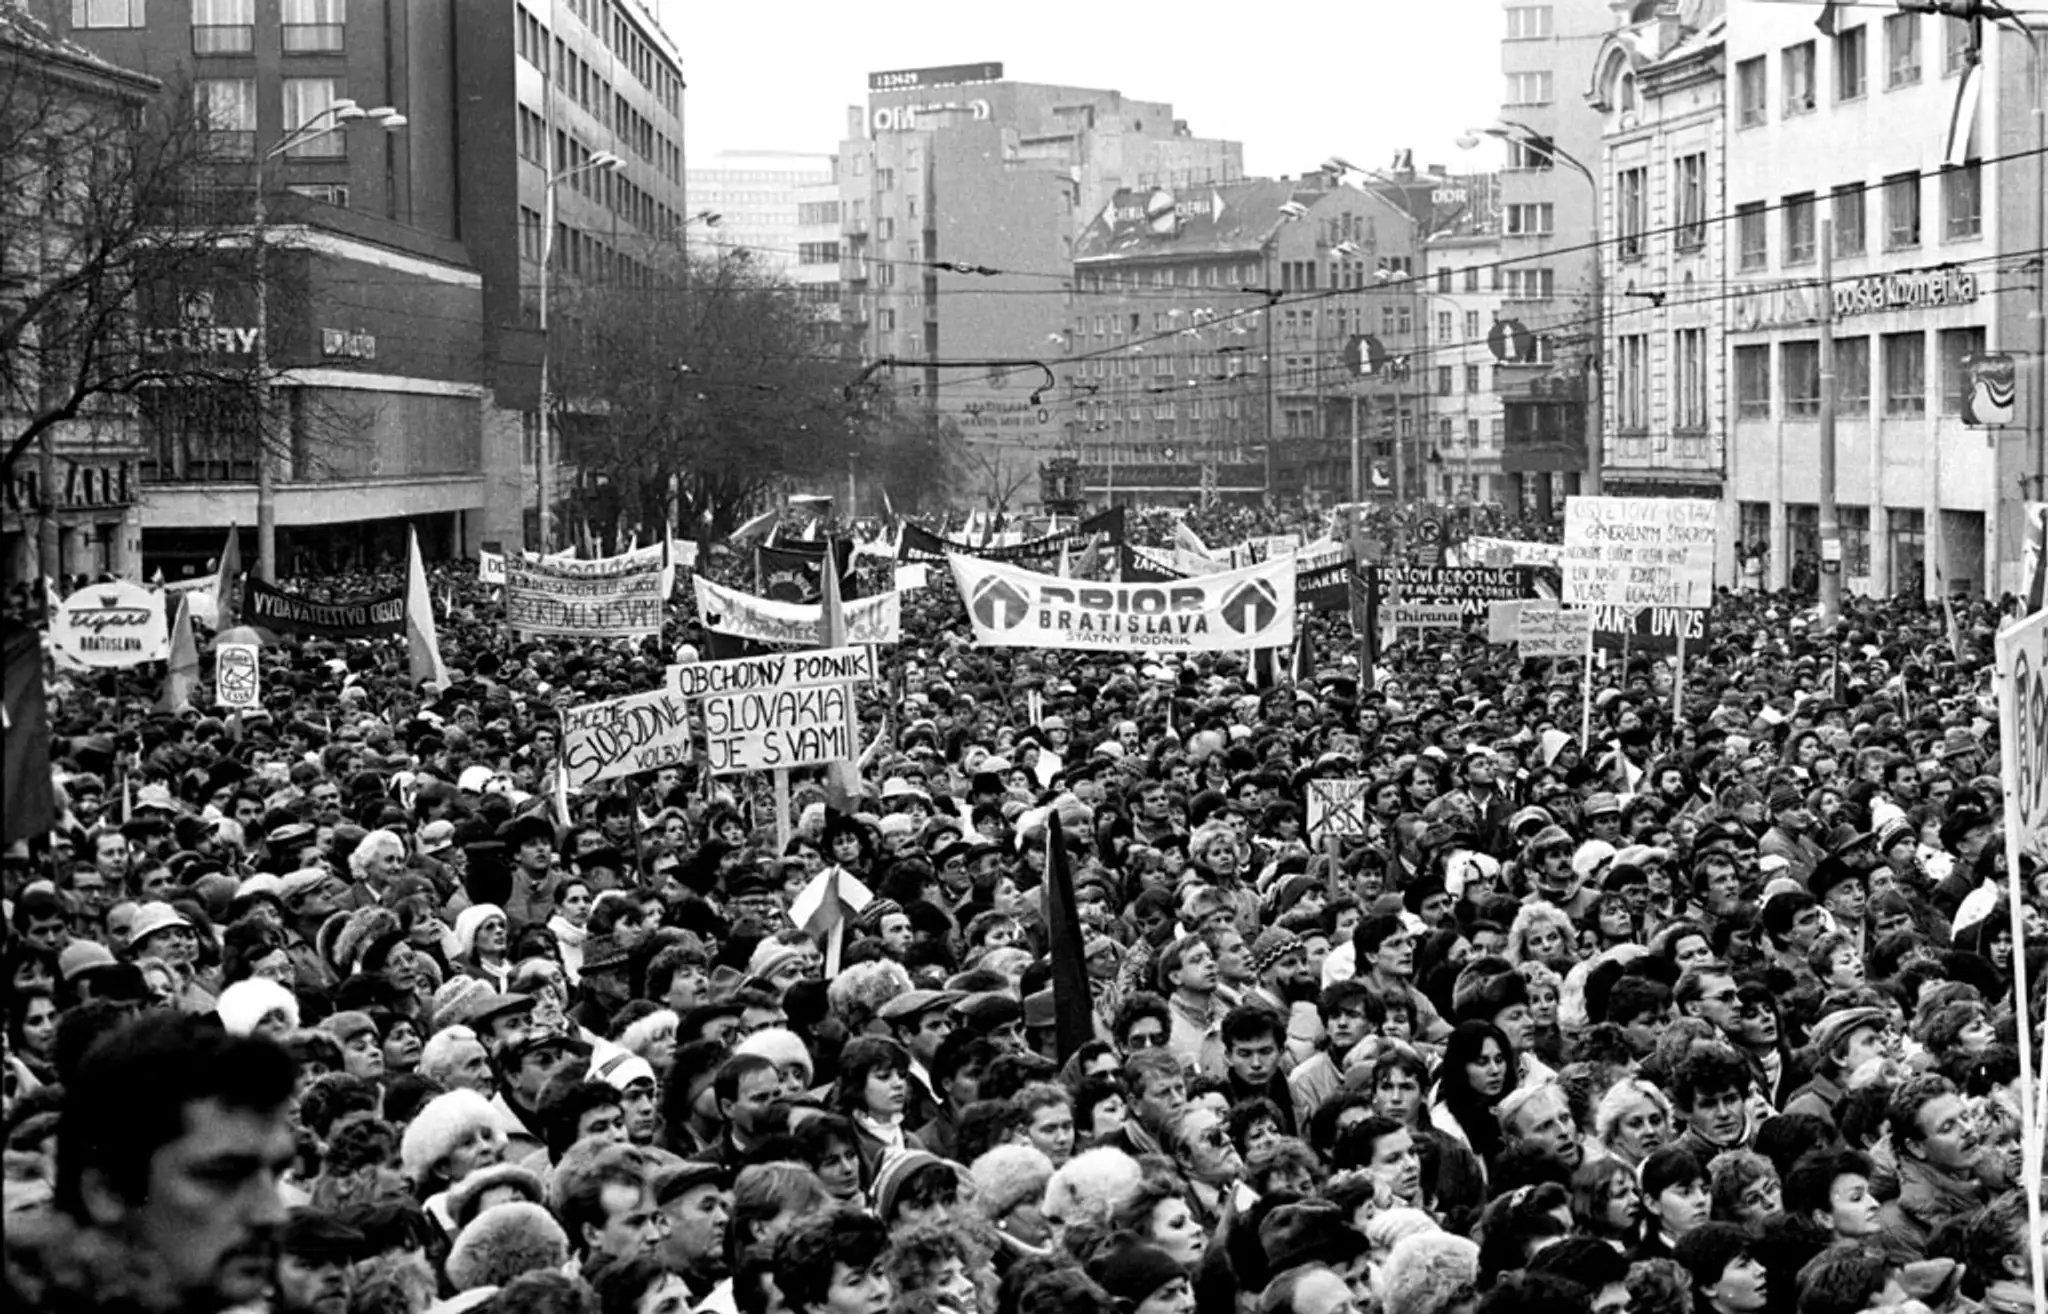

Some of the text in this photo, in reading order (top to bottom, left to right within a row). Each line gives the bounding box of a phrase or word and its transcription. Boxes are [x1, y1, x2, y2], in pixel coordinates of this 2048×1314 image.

[1432, 189, 1466, 204] DDR
[370, 597, 405, 624] OBZO
[1039, 609, 1209, 634] BRATISLAVA
[1395, 609, 1460, 623] Chirana
[80, 636, 142, 651] BRATISLAVA
[1130, 633, 1192, 646] PODNIK
[679, 653, 868, 697] OBCHODNÝ PODNIK
[566, 700, 628, 735] CHCEME
[707, 687, 845, 735] SLOVAKIA
[708, 724, 847, 770] JE S VAMI
